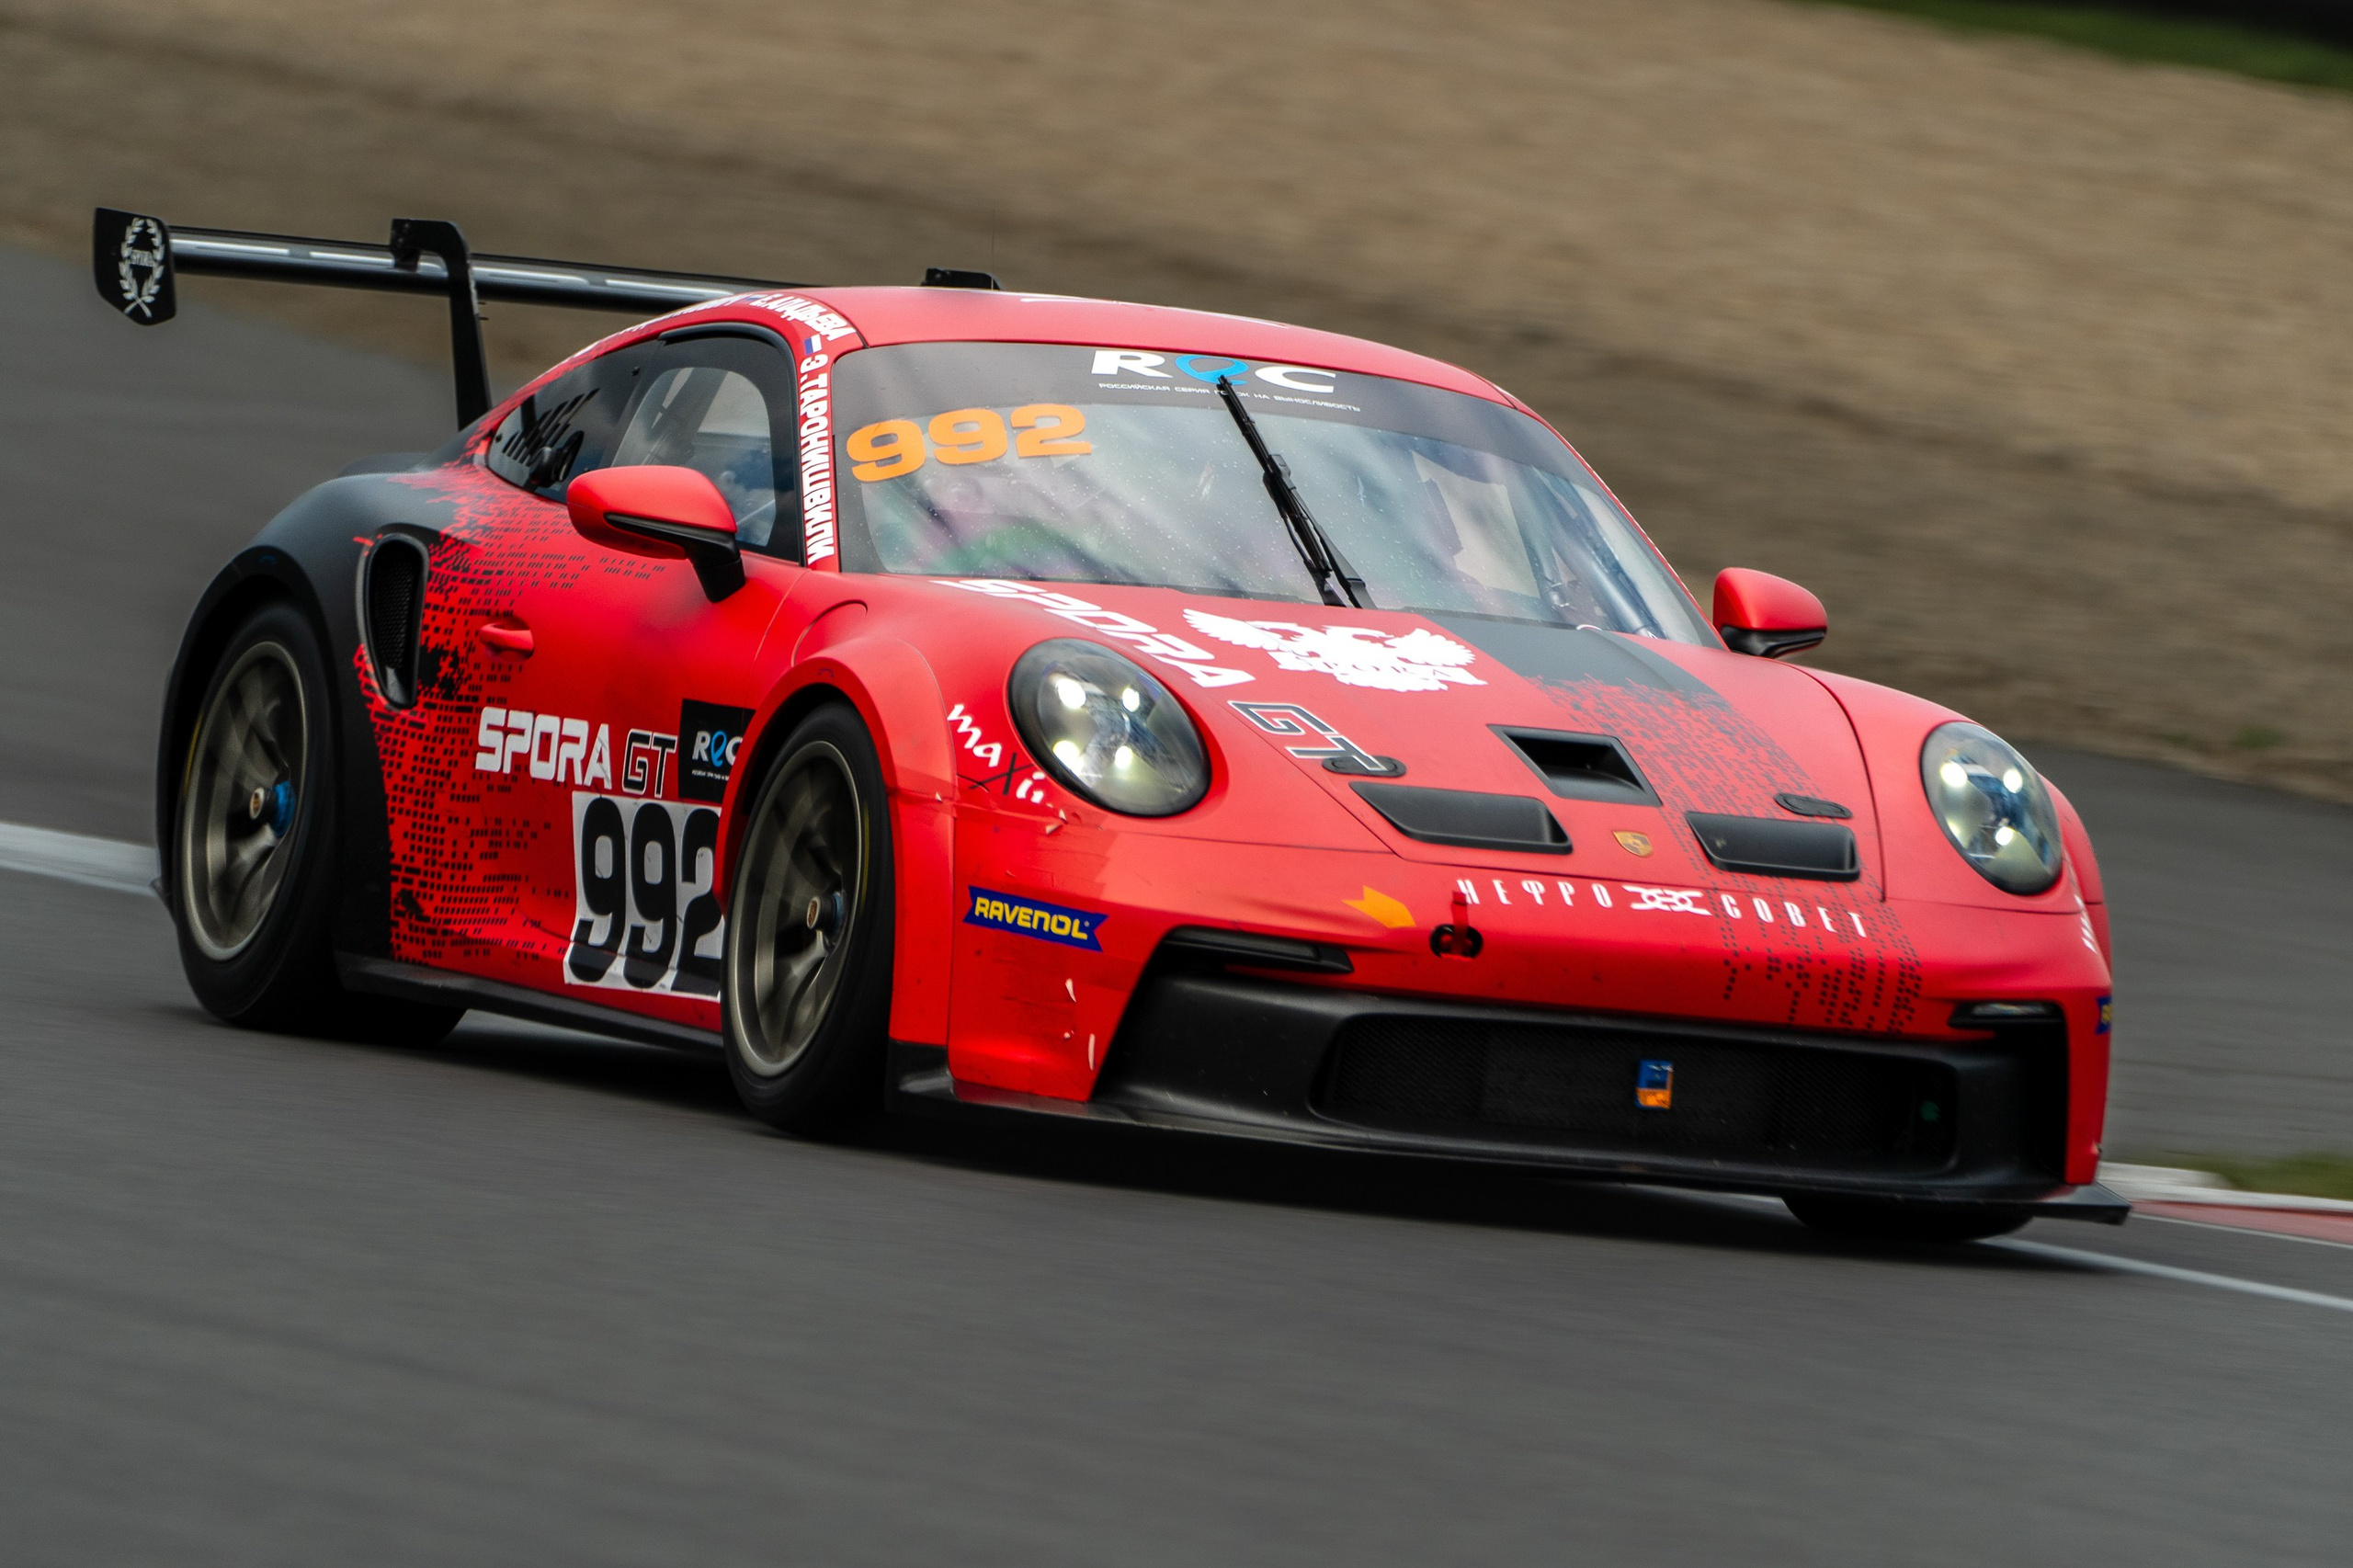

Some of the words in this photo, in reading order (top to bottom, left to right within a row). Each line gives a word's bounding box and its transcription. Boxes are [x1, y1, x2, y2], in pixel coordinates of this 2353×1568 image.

[1098, 382, 1170, 392] РОССИЙСКАЯ
[1175, 386, 1210, 394] СЕРИЯ
[1214, 390, 1250, 398] ГООК
[1274, 395, 1360, 412] ВЫНОСЛИВОСТЬ
[847, 403, 1092, 482] 992
[929, 579, 1256, 688] SPORA
[475, 706, 612, 790] SPORA
[622, 728, 677, 798] GT
[1227, 700, 1389, 772] GT
[568, 797, 725, 997] 992
[974, 896, 1088, 940] RAVENOL
[1721, 893, 1867, 937] СОВЕТ
